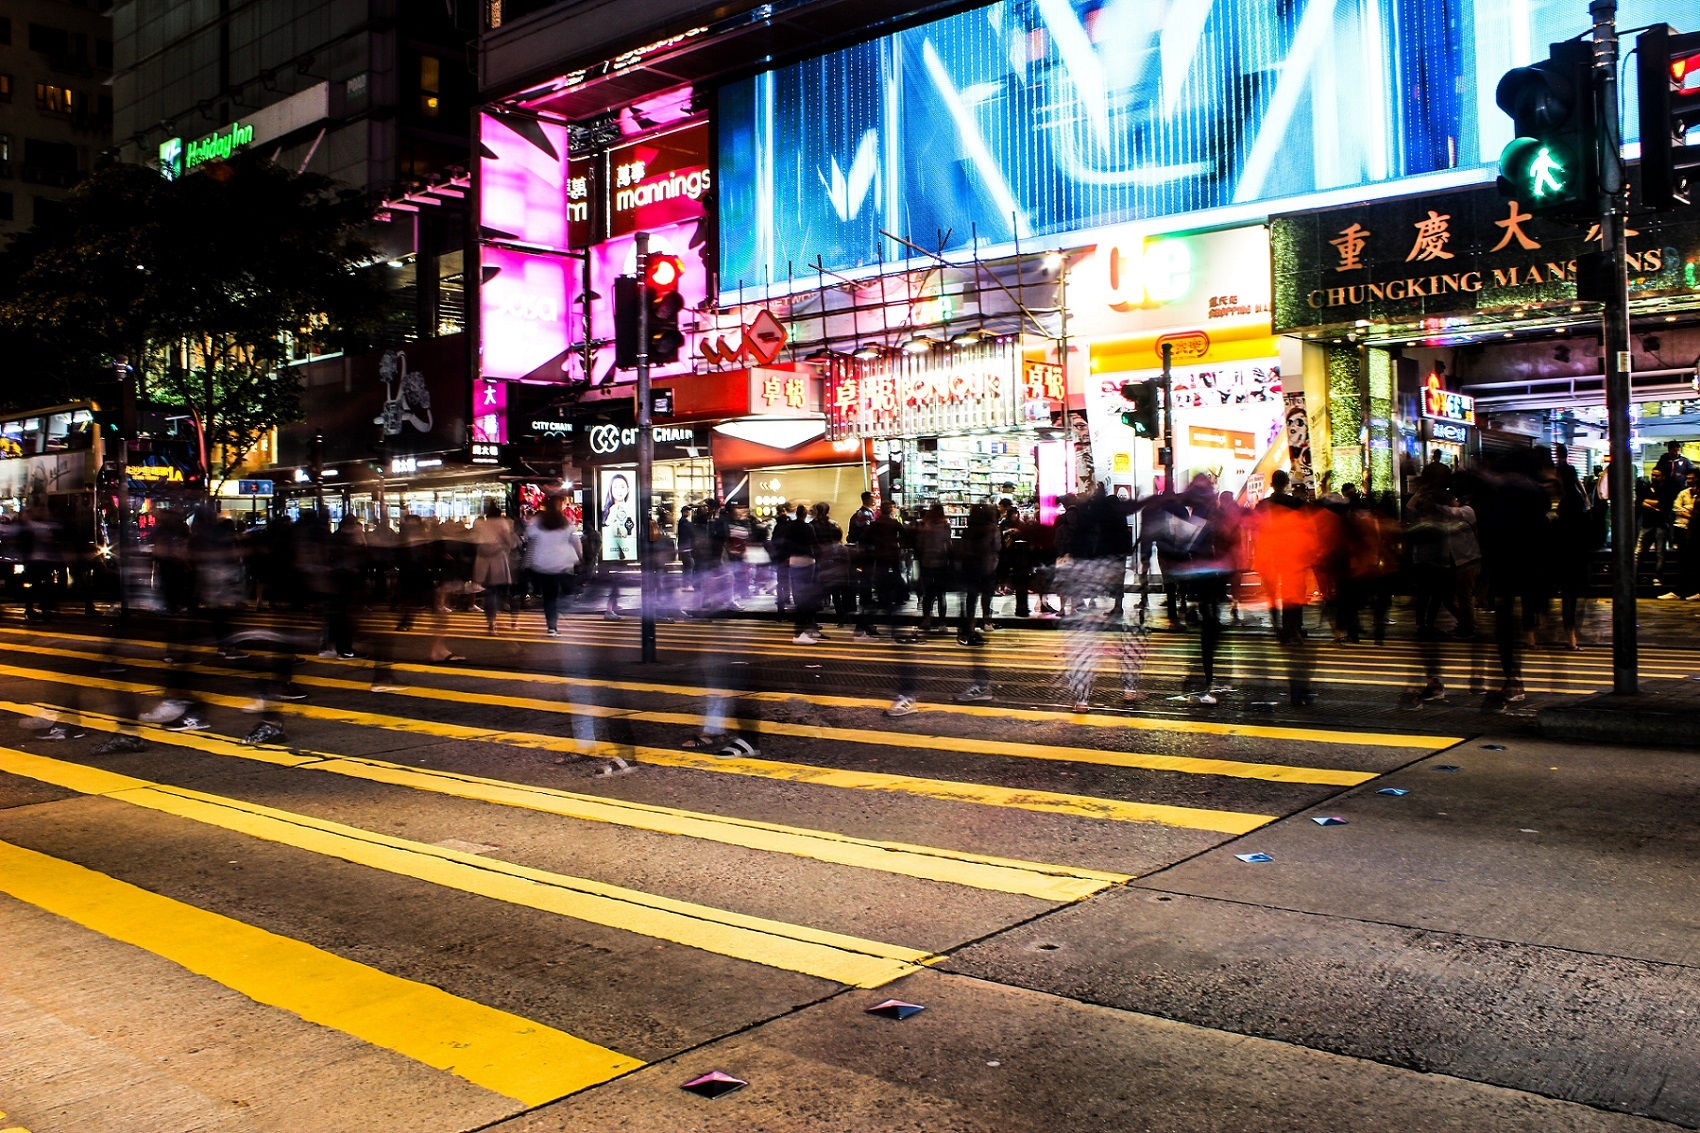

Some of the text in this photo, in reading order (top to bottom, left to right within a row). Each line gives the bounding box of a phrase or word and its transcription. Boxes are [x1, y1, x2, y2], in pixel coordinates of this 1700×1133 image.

[185, 122, 254, 168] Holiday Inn
[616, 168, 711, 211] mannings
[1328, 200, 1640, 273] 重慶大
[1307, 248, 1662, 309] CHUNGKING MANSNS
[531, 420, 573, 432] CITY CHAIN
[621, 427, 693, 446] CI CHAIN
